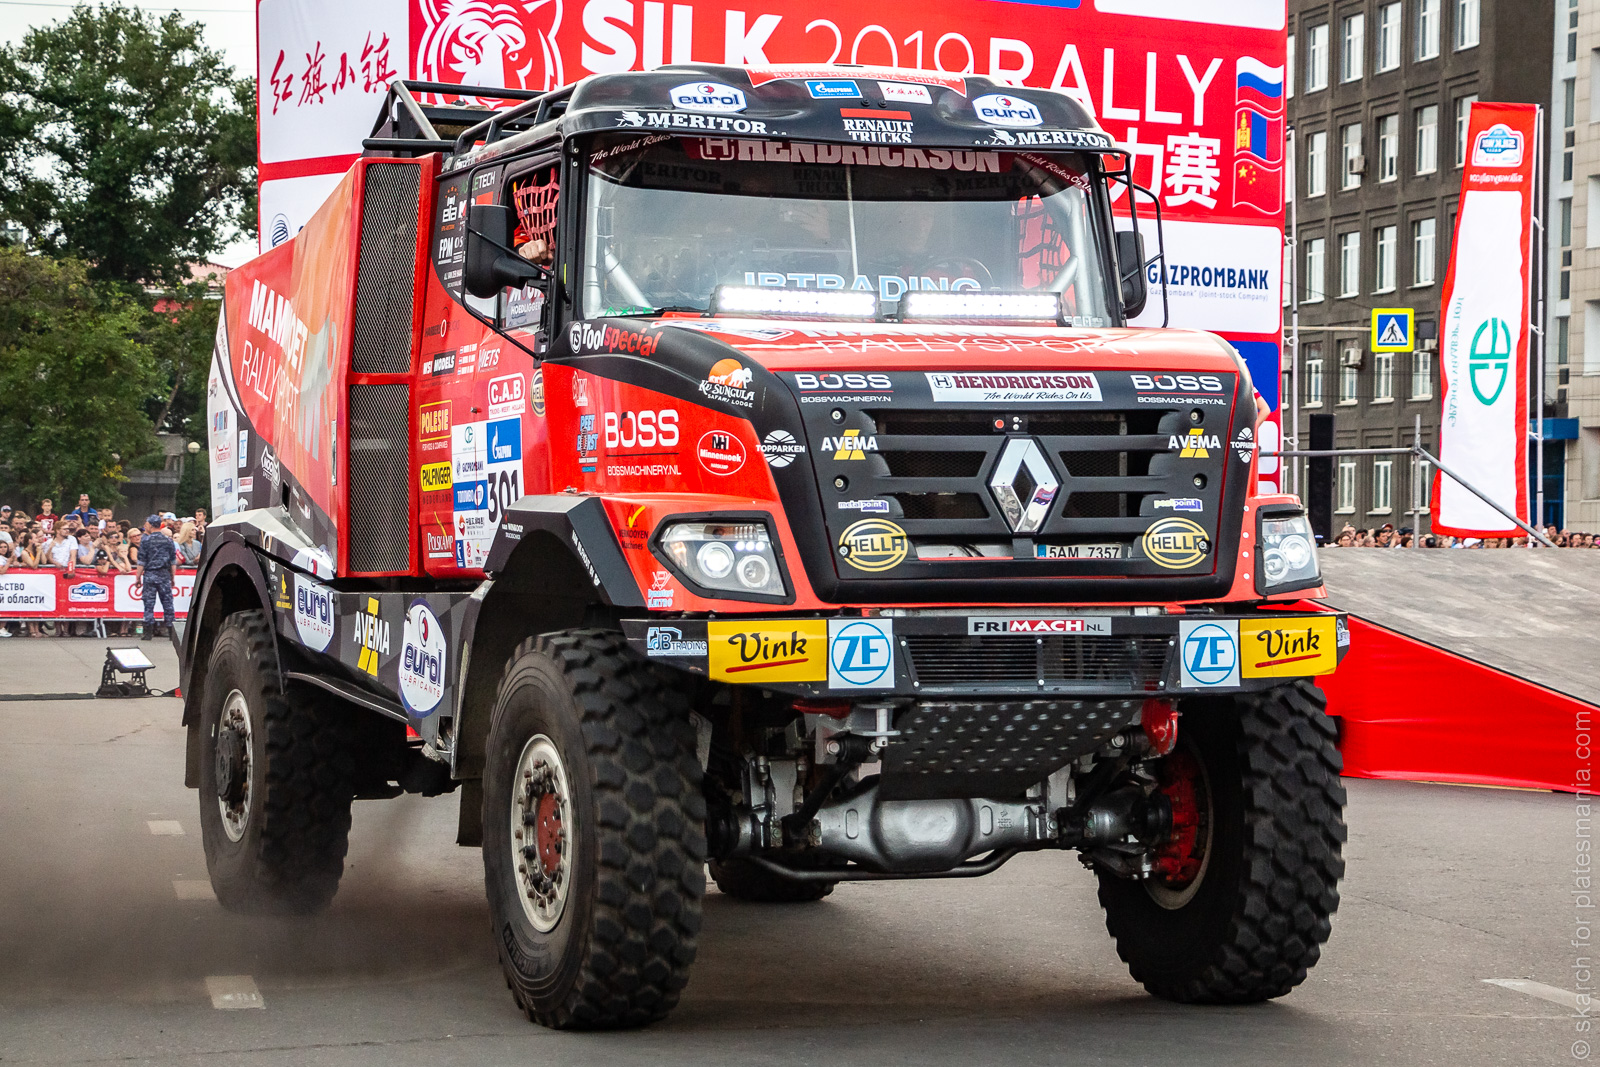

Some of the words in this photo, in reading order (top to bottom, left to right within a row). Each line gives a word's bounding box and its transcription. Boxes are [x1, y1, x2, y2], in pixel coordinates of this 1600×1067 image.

[581, 0, 783, 74] SILK
[989, 37, 1224, 126] RALLY
[678, 93, 740, 105] eurol
[982, 107, 1037, 120] eurol
[647, 111, 768, 135] MERITOR
[842, 118, 914, 133] RENAULT
[848, 131, 912, 144] TRUCKS
[1016, 131, 1109, 148] MERITOR
[590, 149, 608, 164] The
[609, 139, 641, 156] World
[642, 134, 671, 146] Rides
[737, 138, 1000, 173] HENDRICKSON
[1044, 158, 1072, 181] Rides
[1147, 263, 1269, 290] GAZPROMBANK
[814, 335, 1140, 356] RALLYSPORT
[794, 373, 892, 389] BOSS
[952, 375, 1095, 389] HENDRICKSON
[1130, 374, 1223, 391] BOSS
[731, 399, 754, 409] LODGE
[984, 392, 1002, 400] The
[1003, 391, 1035, 400] World
[1036, 391, 1064, 400] Rides
[1065, 391, 1079, 399] On
[1079, 391, 1092, 400] Us
[1137, 396, 1226, 406] BOSSMACHINERY.NL
[421, 408, 449, 435] POLESIE
[604, 408, 680, 448] BOSS
[755, 444, 806, 453] TOPPARKEN
[820, 436, 879, 451] AVEMA
[1168, 435, 1222, 449] AVEMA
[422, 466, 452, 487] PALFINGER
[607, 464, 682, 476] BOSSMACHINERY.NL
[486, 469, 519, 524] 301
[838, 501, 883, 511] metalpoint
[621, 540, 644, 550] Machines
[849, 535, 906, 553] HELLA
[1049, 545, 1080, 558] 5AM
[1087, 545, 1120, 558] 7357
[7, 592, 45, 604] области
[297, 584, 334, 627] eurol
[353, 610, 391, 656] AVEMA
[1086, 623, 1104, 632] NL
[728, 630, 808, 663] Vink
[1256, 626, 1320, 658] Vink
[835, 635, 889, 672] ZF
[1187, 636, 1235, 672] ZF
[404, 642, 443, 687] eurol
[400, 671, 442, 699] LUBRICANTS
